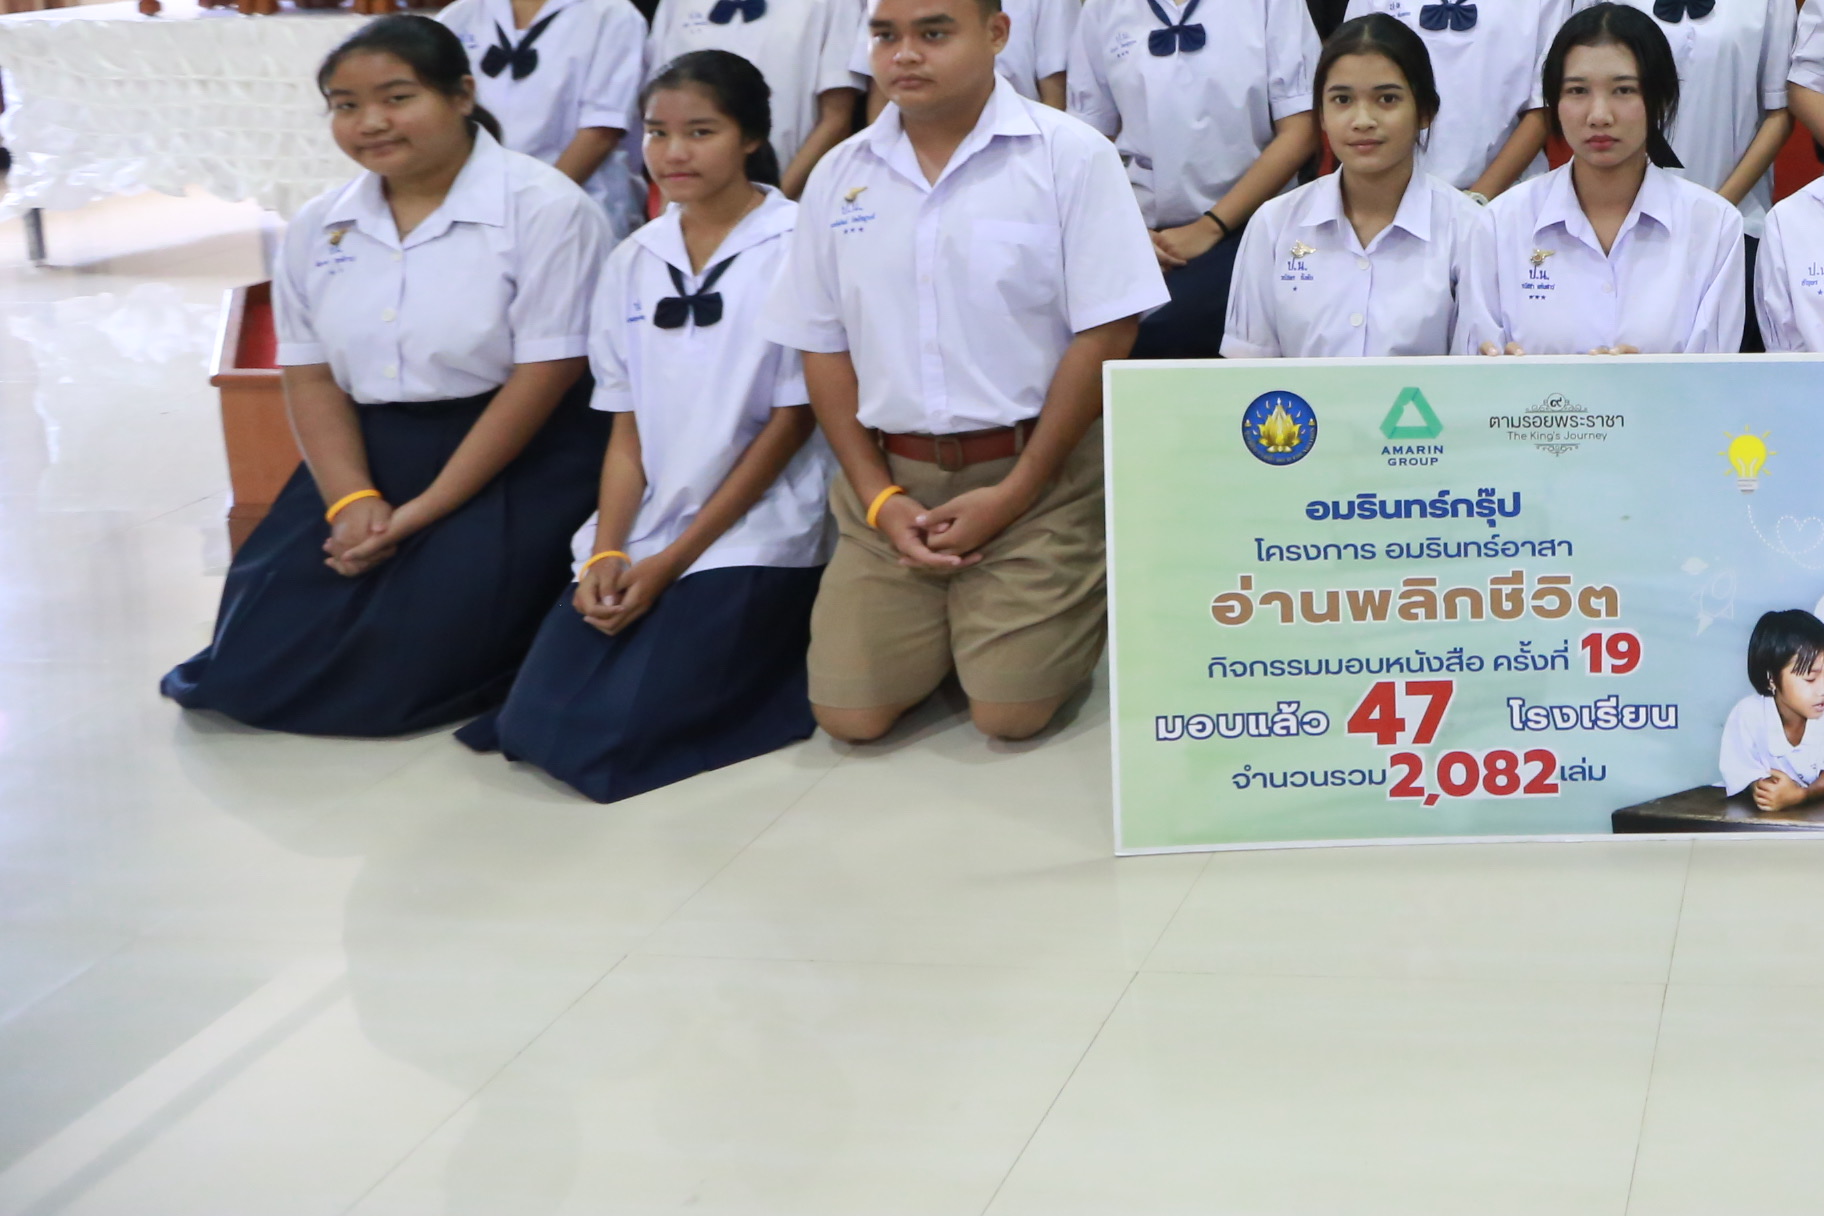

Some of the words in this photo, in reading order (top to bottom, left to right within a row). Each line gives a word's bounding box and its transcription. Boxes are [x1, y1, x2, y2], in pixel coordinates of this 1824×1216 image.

[1489, 414, 1625, 429] ตามรอยพระราชา
[1507, 431, 1528, 441] The
[1530, 431, 1561, 442] King's
[1563, 431, 1608, 442] Journey
[1381, 445, 1444, 456] AMARIN
[1387, 457, 1438, 467] GROUP
[1305, 488, 1521, 528] อมรินทร์กรุ๊ป
[1255, 537, 1377, 562] โครงการ
[1384, 533, 1573, 560] อมรินทร์อาสา
[1211, 571, 1620, 626] อ่านพลิกชีวิต
[1207, 646, 1485, 680] กิจกรรมมอบหนังสือ
[1493, 639, 1569, 672] ครั้งที่
[1581, 632, 1641, 674] 19
[1155, 700, 1331, 742] มอบแล้ว
[1347, 680, 1454, 745] 47
[1506, 695, 1679, 732] โรงเรียน
[1231, 764, 1387, 790] จำนวนรวม
[1389, 748, 1560, 806] 2,082
[1560, 756, 1607, 782] เล่ม
